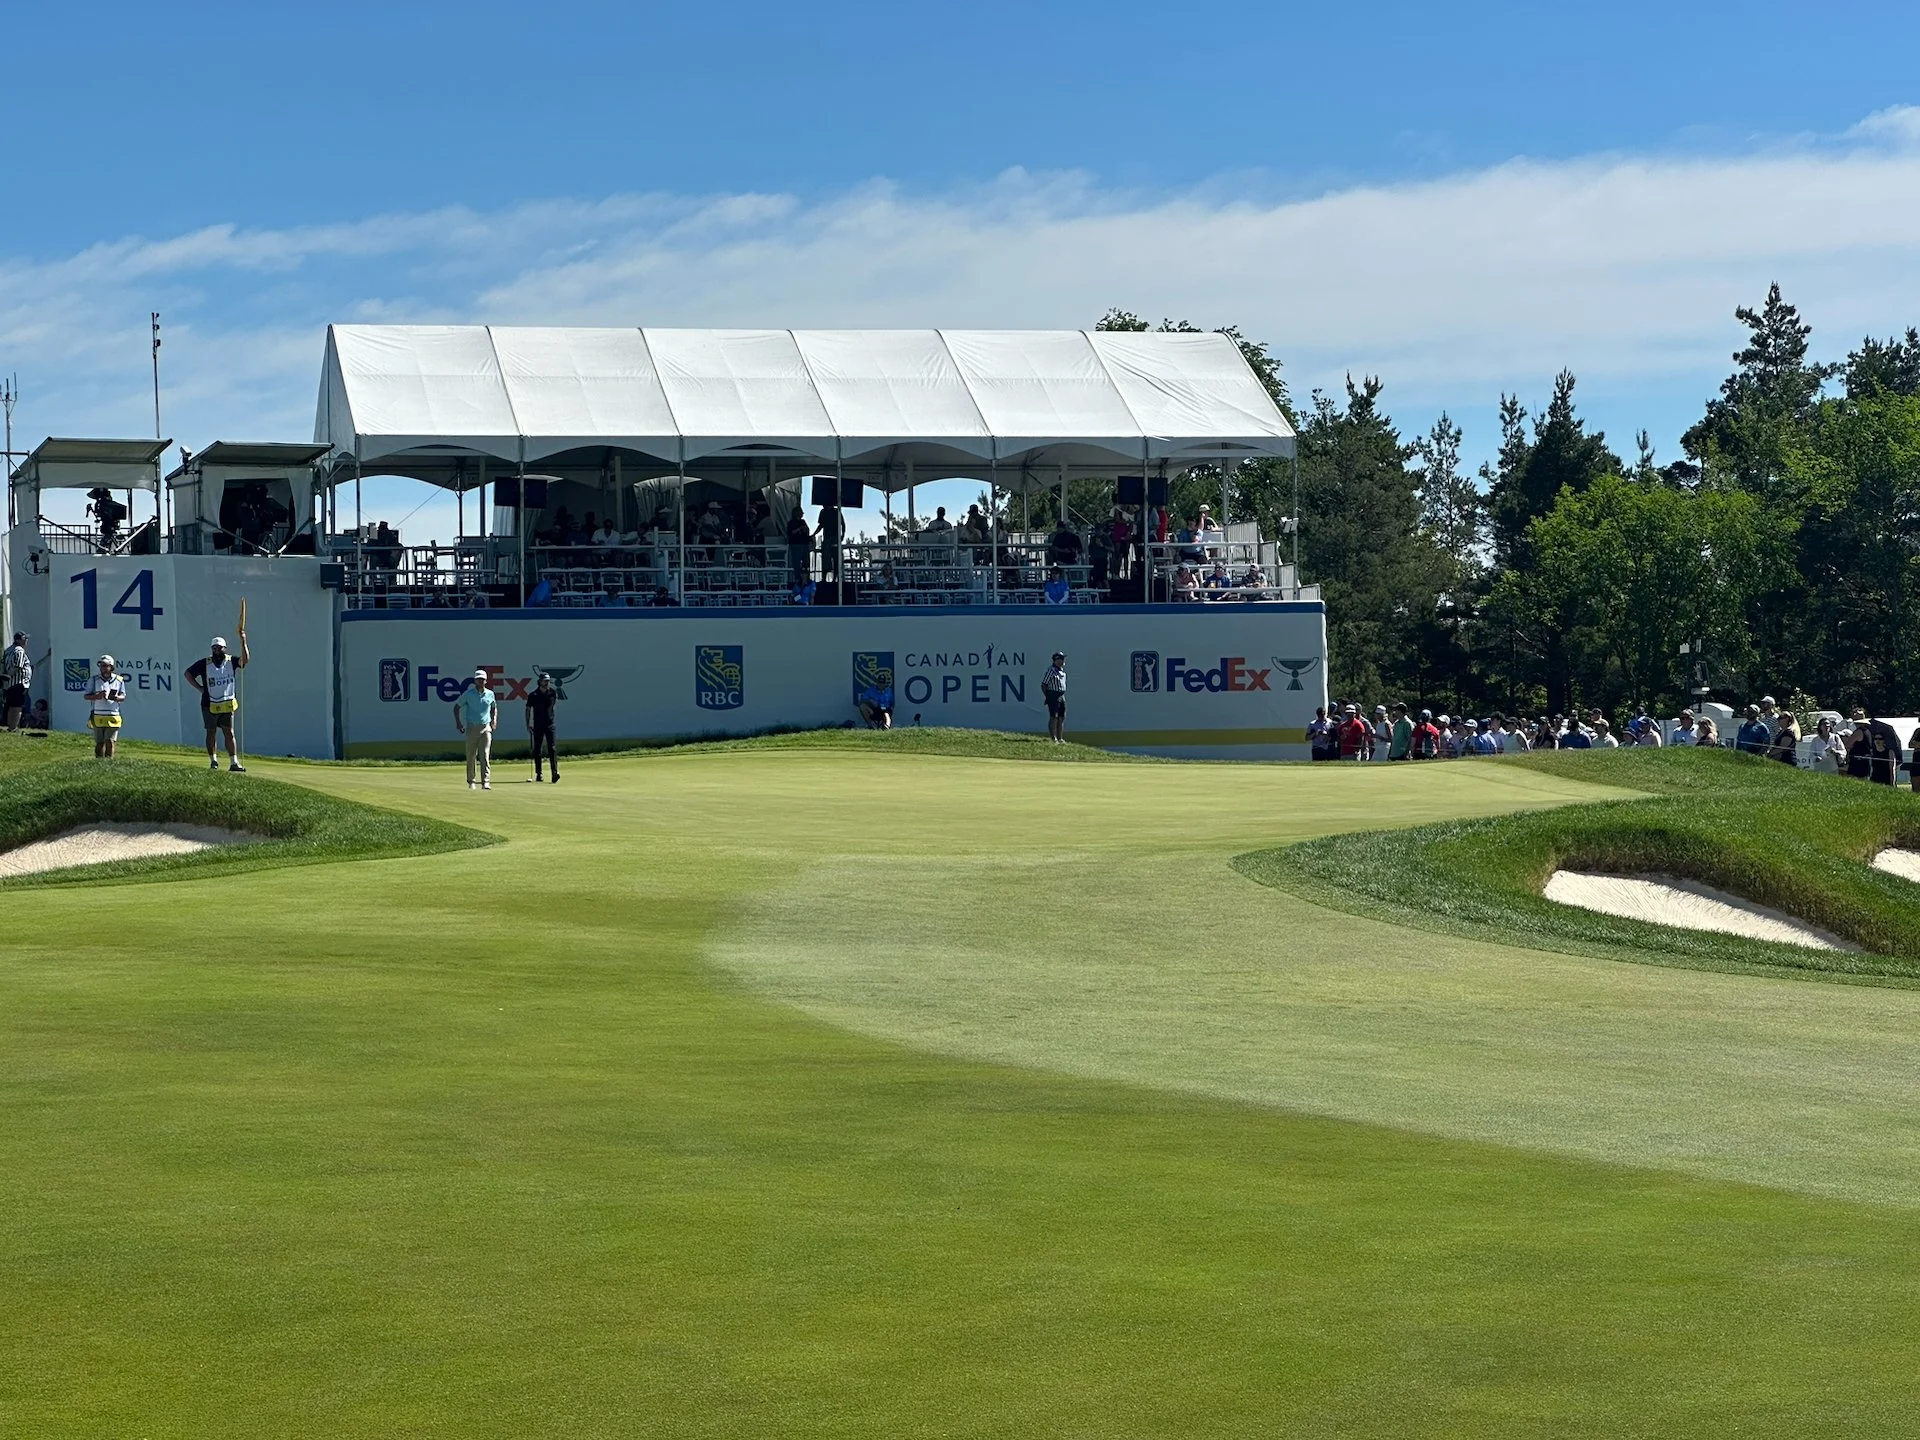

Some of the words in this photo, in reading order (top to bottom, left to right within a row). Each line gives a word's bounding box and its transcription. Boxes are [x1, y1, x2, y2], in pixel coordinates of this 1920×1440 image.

[70, 568, 164, 631] 14
[99, 658, 172, 671] NADIAN
[905, 647, 1025, 668] CANADIAN
[118, 673, 172, 692] PEN
[1166, 657, 1272, 693] FedEx
[701, 691, 740, 706] RBC
[904, 675, 1025, 704] OPEN
